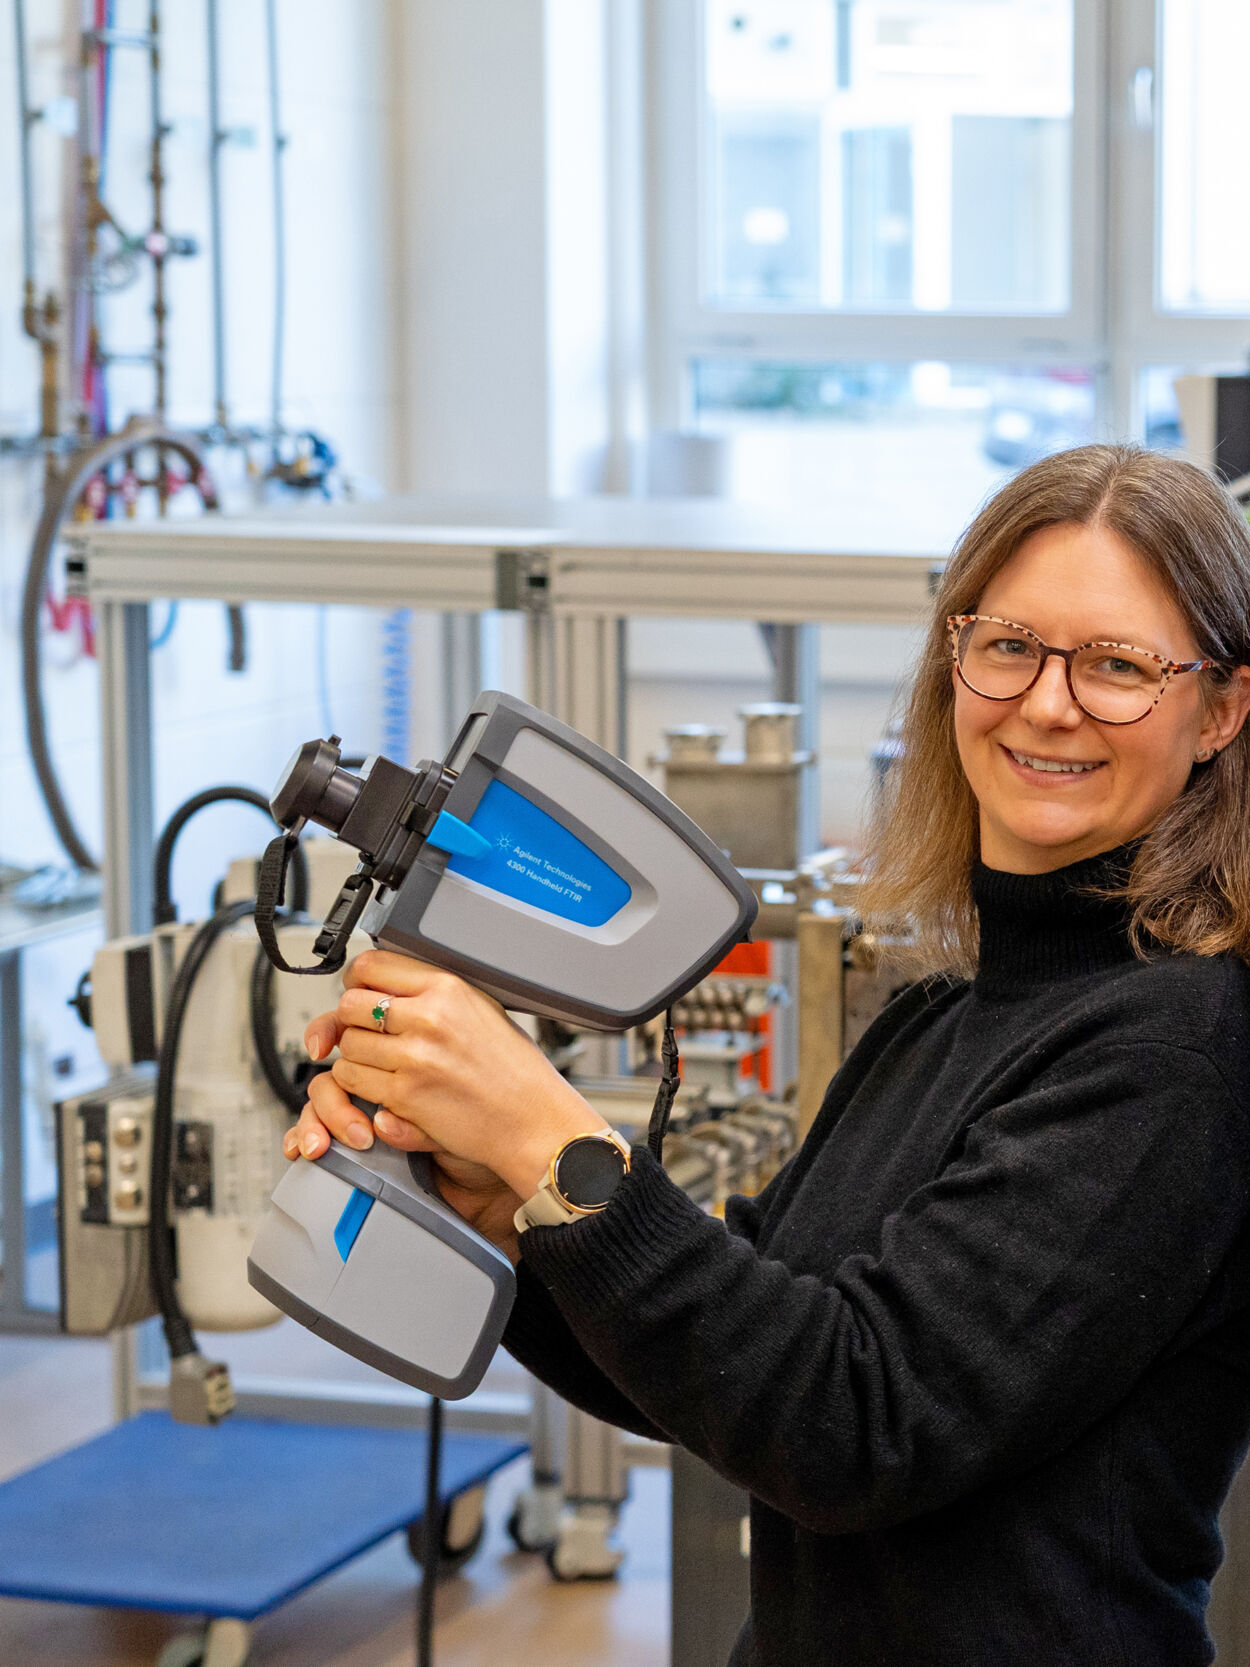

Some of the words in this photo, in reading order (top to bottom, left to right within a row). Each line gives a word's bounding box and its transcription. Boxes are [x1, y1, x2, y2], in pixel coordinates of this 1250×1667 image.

[506, 859, 526, 873] 4300
[526, 869, 563, 893] Handheld
[563, 889, 582, 903] FTIR
[513, 846, 541, 865] Agilent
[543, 860, 592, 892] Technologies
